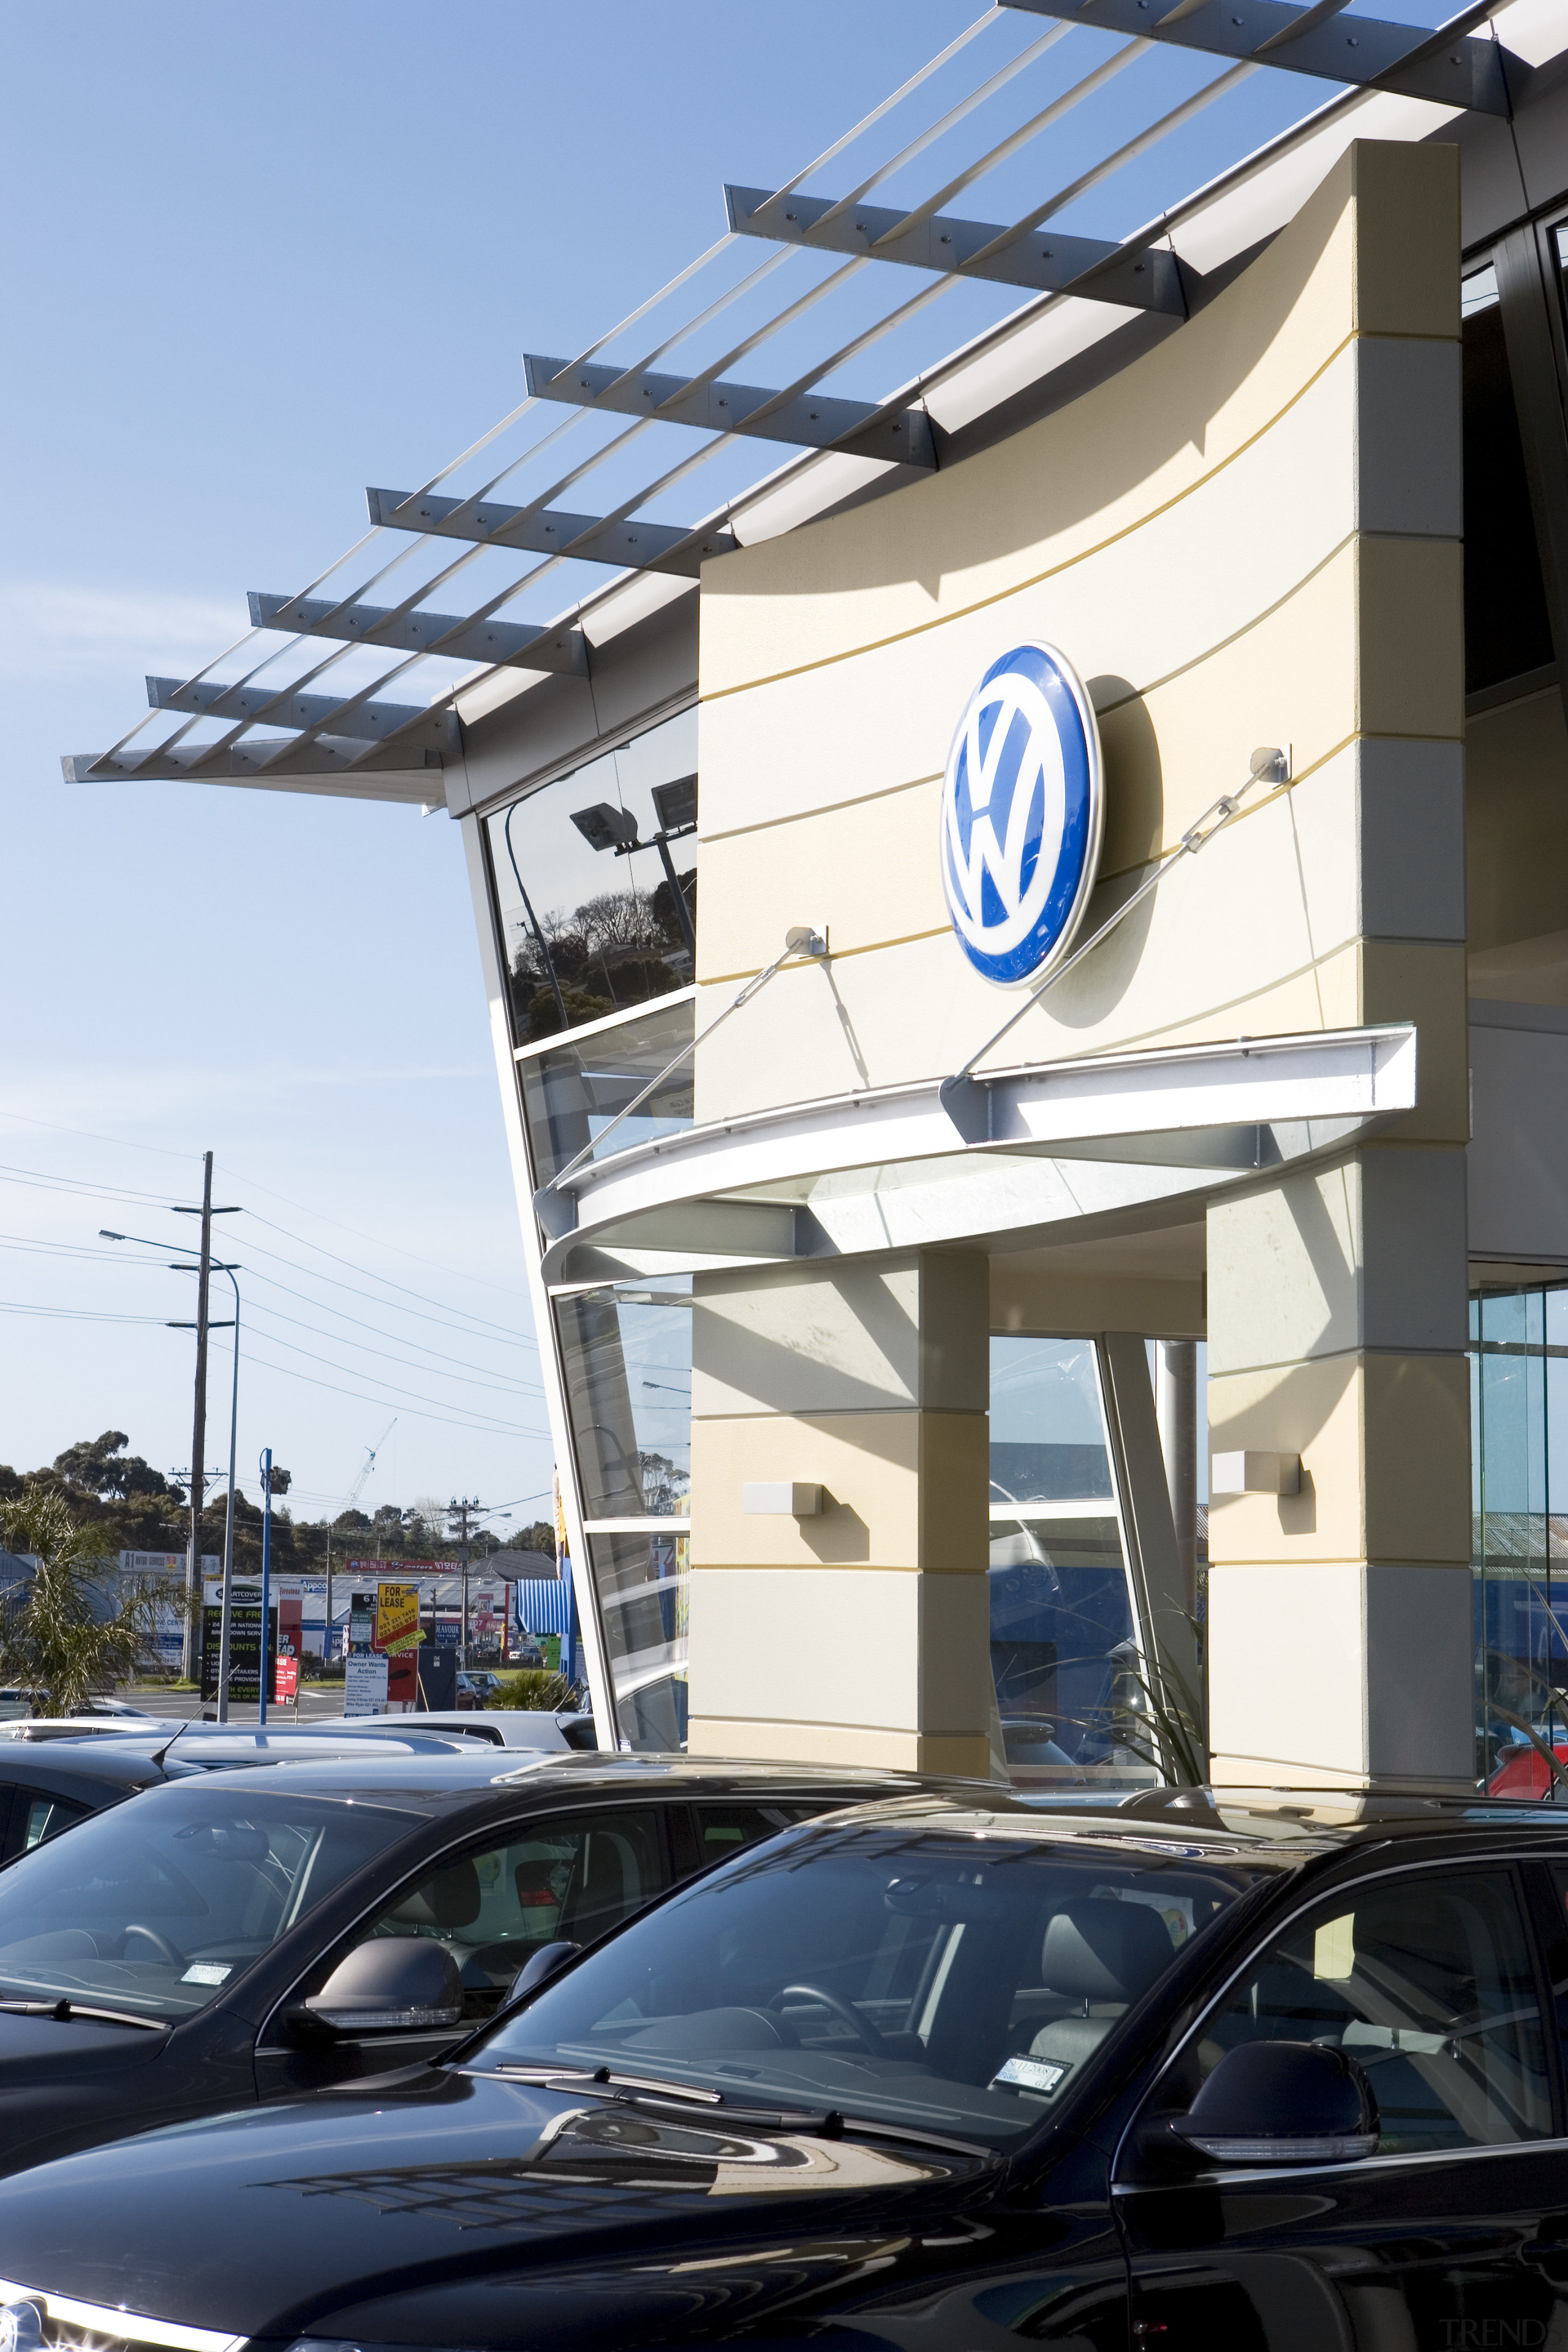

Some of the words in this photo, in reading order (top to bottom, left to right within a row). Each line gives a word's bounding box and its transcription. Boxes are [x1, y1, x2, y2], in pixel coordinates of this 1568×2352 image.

[125, 1552, 134, 1568] A1
[385, 1586, 400, 1597] FOR
[380, 1597, 404, 1608] LEASE
[379, 1621, 390, 1630] 021
[402, 1608, 415, 1618] 7416
[380, 1628, 391, 1637] 021
[404, 1615, 415, 1624] 977
[1042, 2058, 1071, 2068] European
